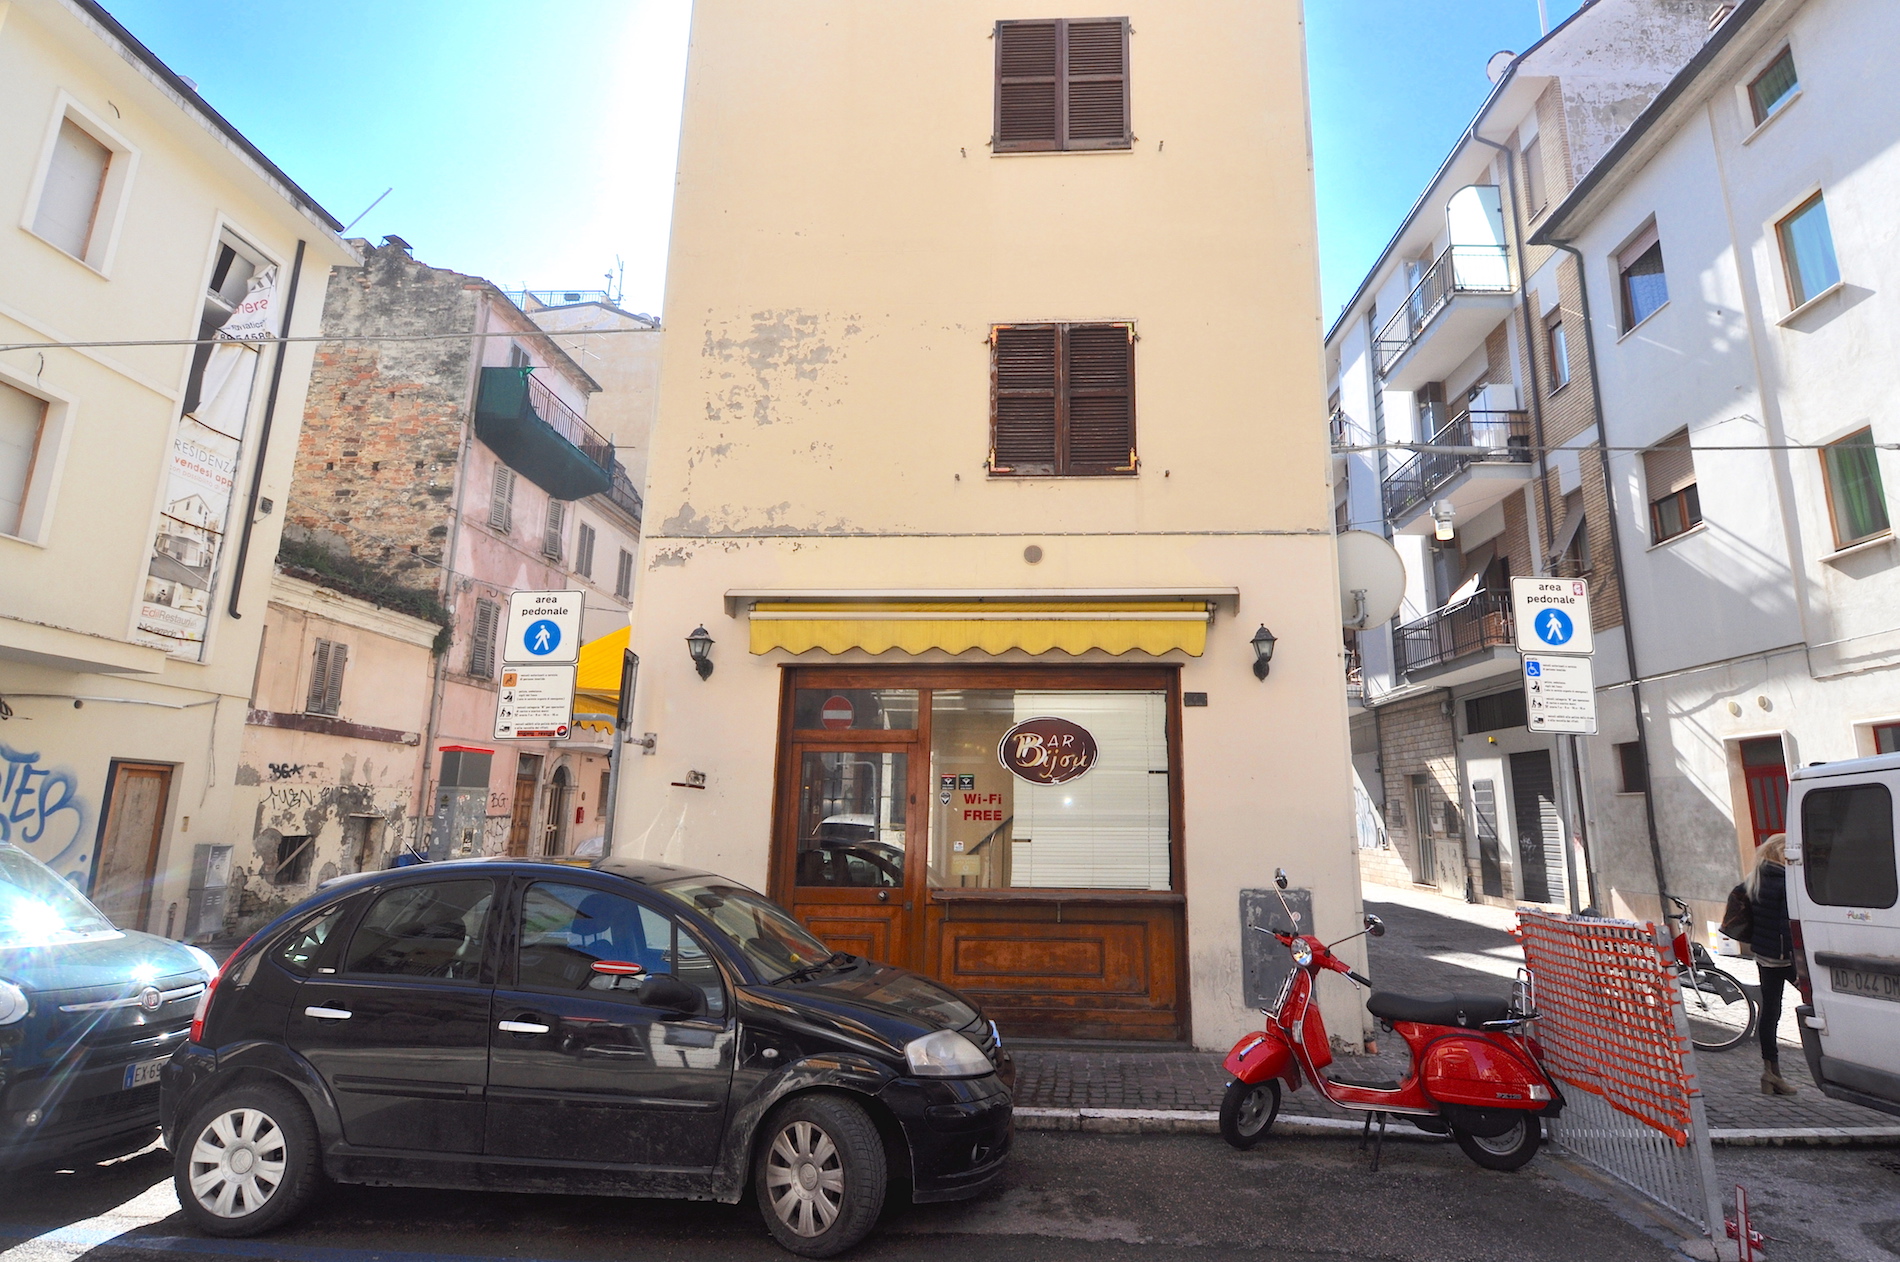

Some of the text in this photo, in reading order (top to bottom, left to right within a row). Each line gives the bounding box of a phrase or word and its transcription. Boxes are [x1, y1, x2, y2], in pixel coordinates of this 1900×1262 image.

[174, 455, 234, 488] vendesi app
[1538, 582, 1562, 592] area
[535, 596, 558, 604] area
[1527, 594, 1576, 605] pedonale
[521, 606, 569, 617] pedonale
[963, 793, 1002, 805] Wi-Fi
[963, 809, 1002, 821] FREE
